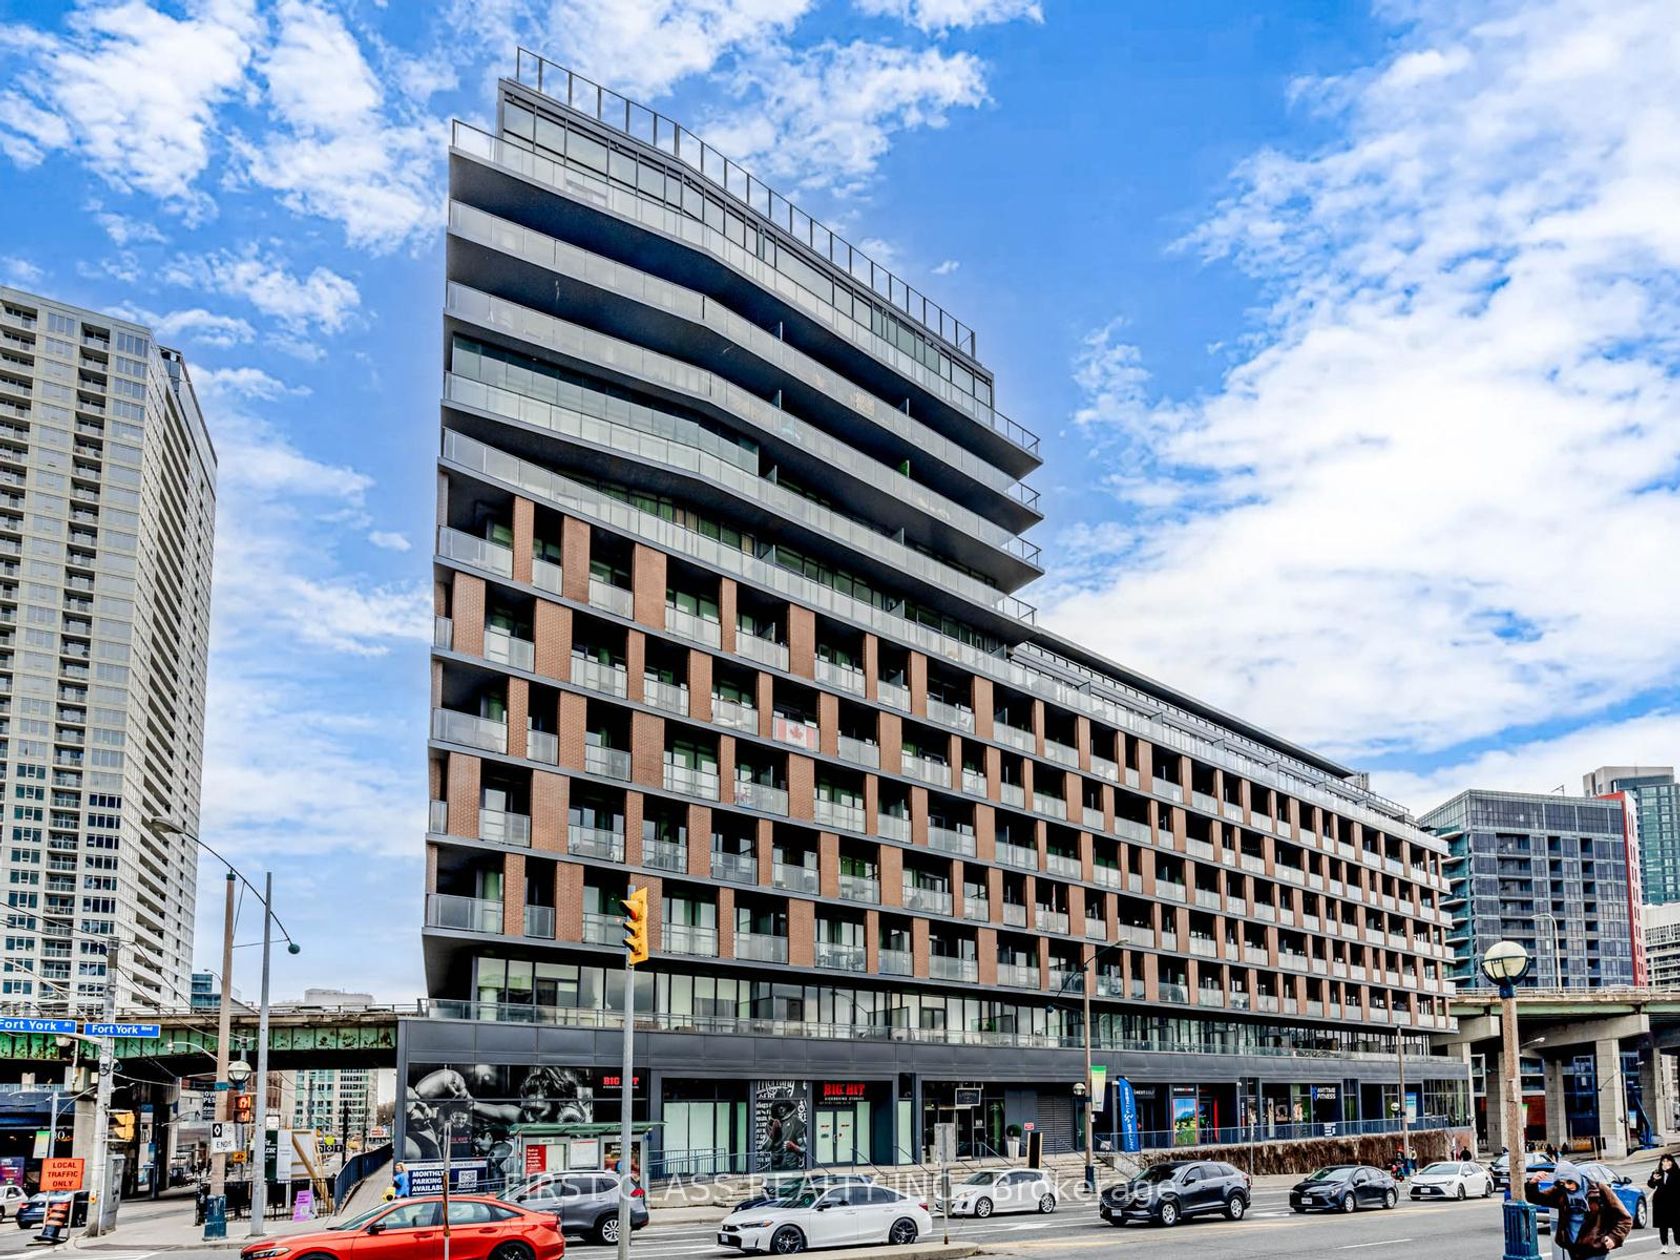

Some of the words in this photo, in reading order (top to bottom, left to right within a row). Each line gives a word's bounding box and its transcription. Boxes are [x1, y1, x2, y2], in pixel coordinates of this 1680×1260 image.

[0, 1019, 25, 1030] Fort
[29, 1020, 57, 1031] York
[92, 1025, 114, 1034] Fort
[116, 1025, 138, 1034] York
[603, 1076, 620, 1085] BIG
[823, 1083, 843, 1096] BIG
[846, 1083, 865, 1096] HIT
[412, 1170, 444, 1178] MONTHLY
[412, 1178, 442, 1186] PARKING
[412, 1185, 444, 1193] AVAILABL
